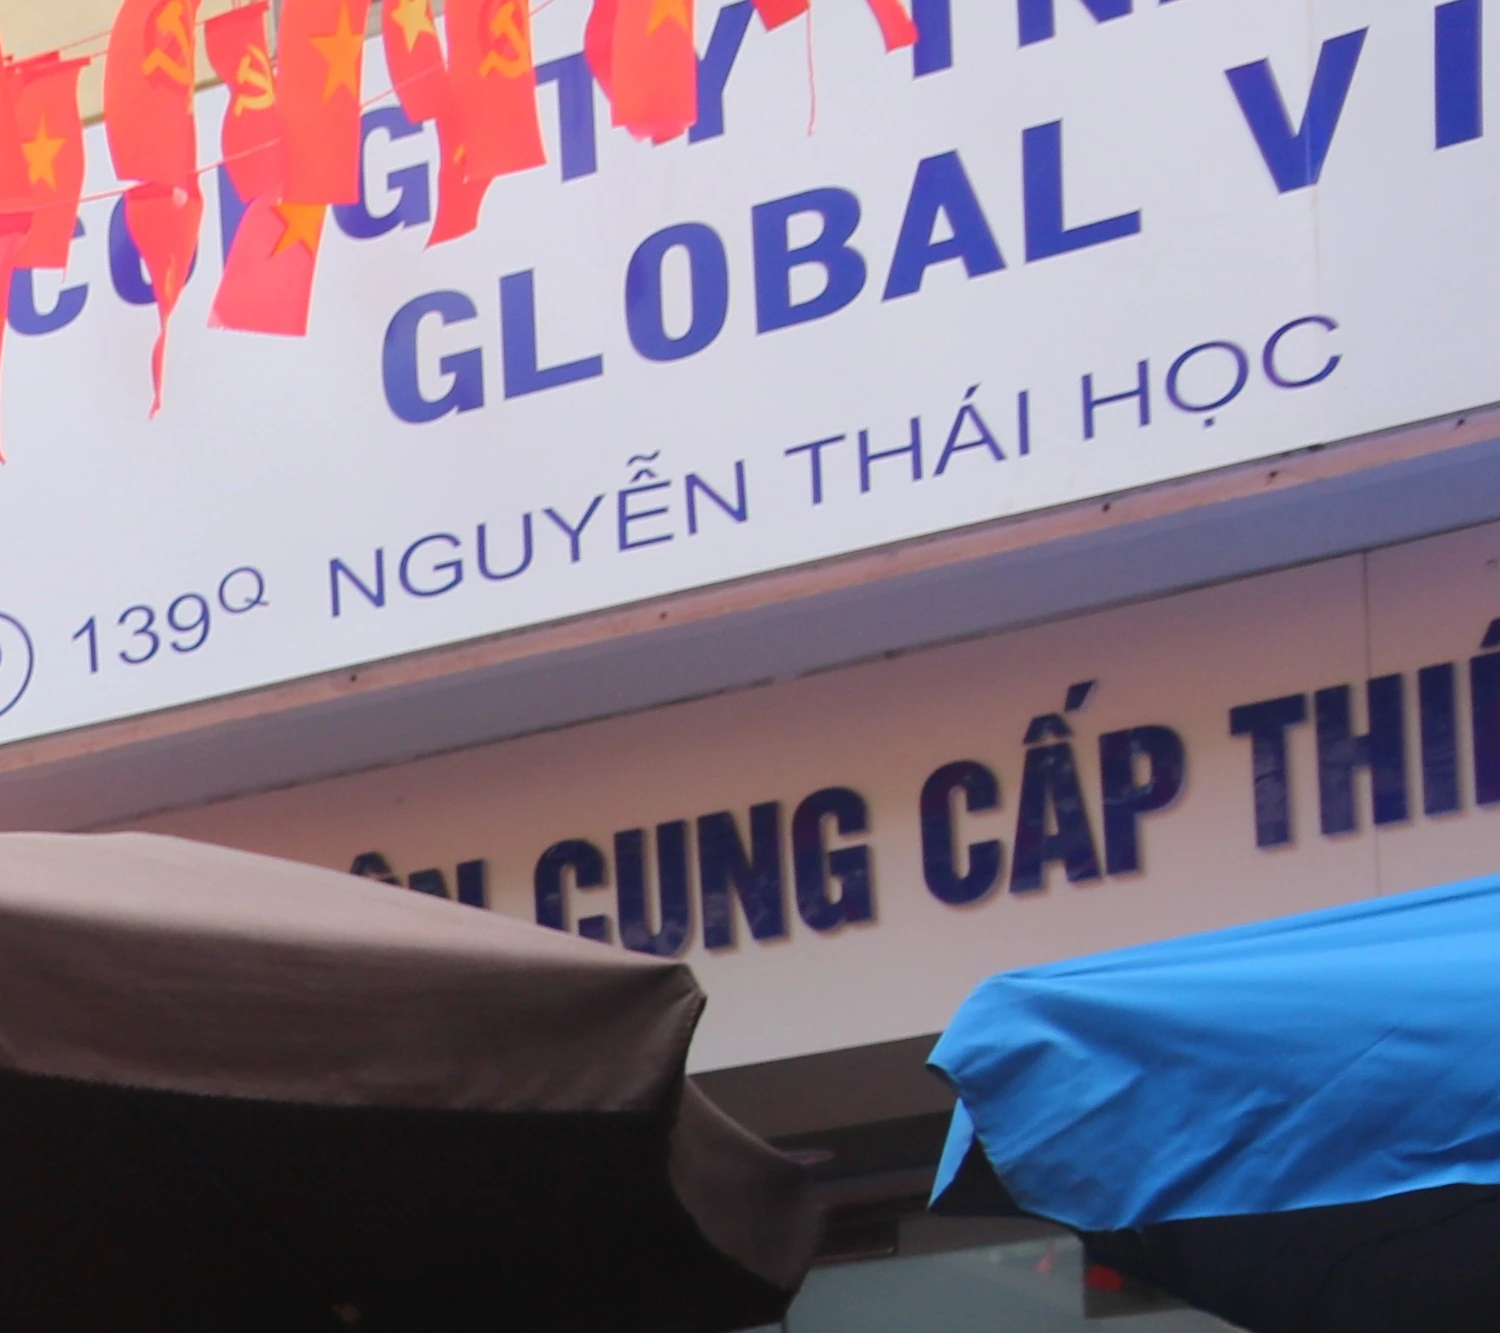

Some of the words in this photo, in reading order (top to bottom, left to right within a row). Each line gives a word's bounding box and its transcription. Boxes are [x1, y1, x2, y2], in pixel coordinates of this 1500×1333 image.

[381, 119, 1142, 425] GLOBAL
[328, 450, 749, 618] NGUYỄN
[784, 383, 1030, 493] THÁI
[1080, 314, 1343, 440] HỌC
[532, 787, 876, 960] CUNG
[918, 680, 1187, 908] CẤP
